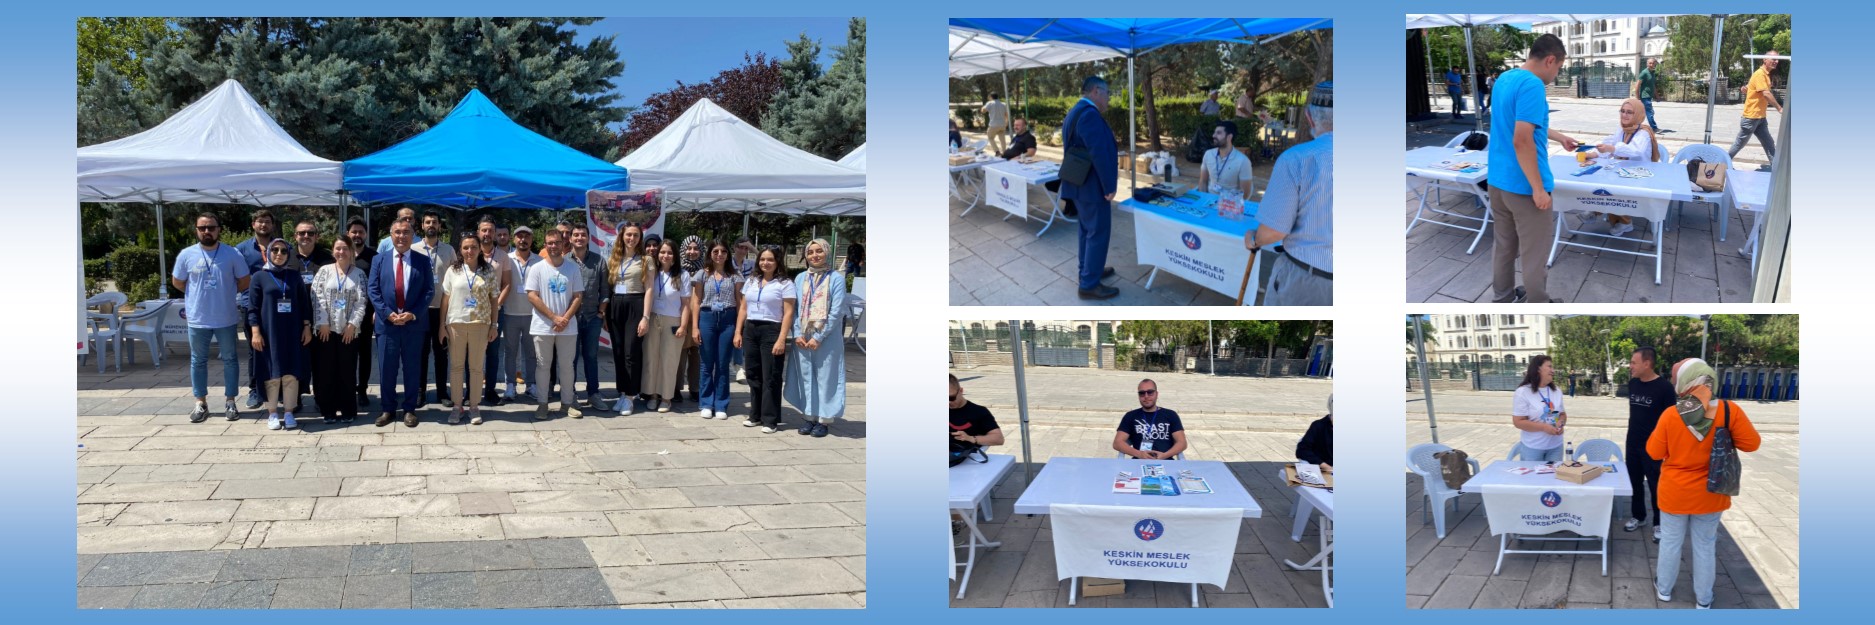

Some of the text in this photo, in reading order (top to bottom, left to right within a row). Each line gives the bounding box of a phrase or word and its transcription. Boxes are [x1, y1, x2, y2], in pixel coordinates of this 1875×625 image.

[1165, 248, 1225, 275] KESKİN MESLEK
[1168, 256, 1225, 282] YÜKSEKOKULU
[1552, 512, 1583, 521] MESLEK
[1525, 518, 1582, 527] YÜKSEKOKULU
[1103, 549, 1191, 560] KESKİN MESLEK
[1108, 558, 1188, 569] YÜKSEKOKULU
